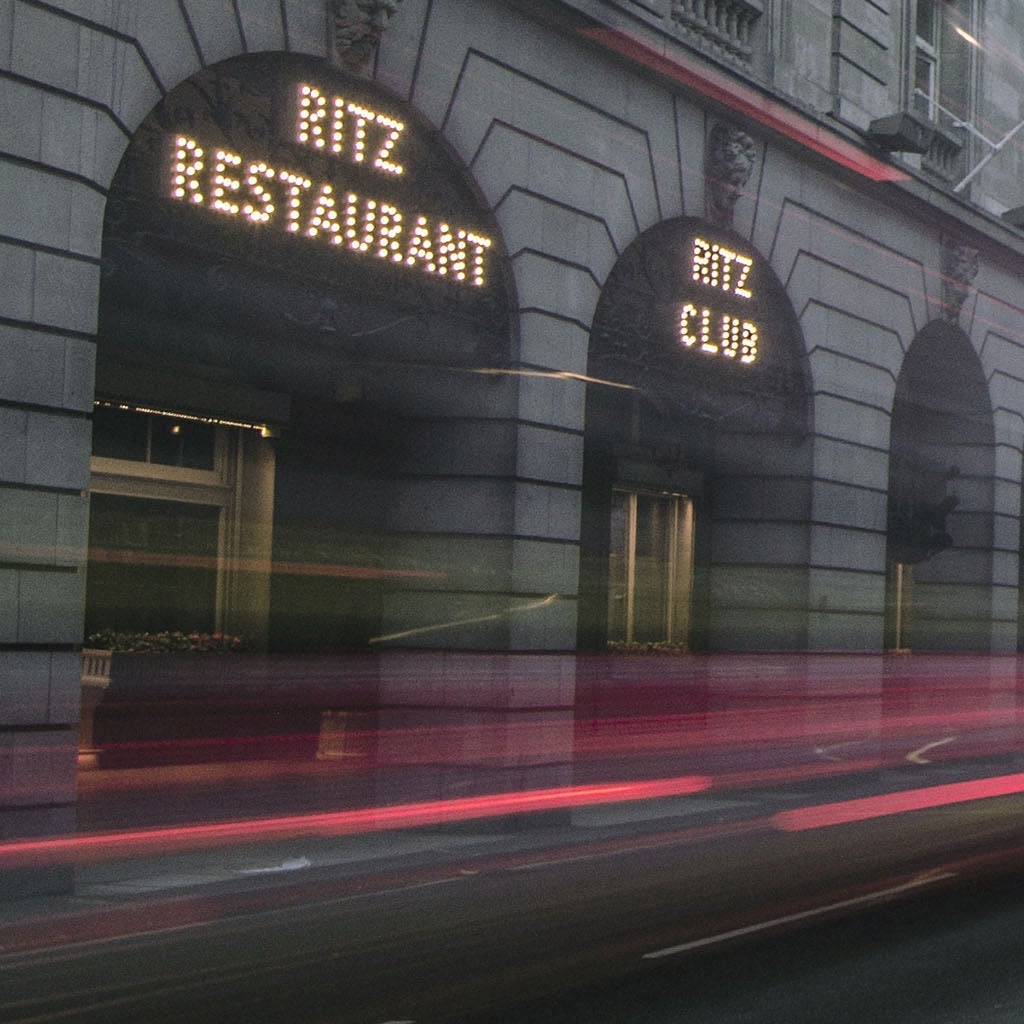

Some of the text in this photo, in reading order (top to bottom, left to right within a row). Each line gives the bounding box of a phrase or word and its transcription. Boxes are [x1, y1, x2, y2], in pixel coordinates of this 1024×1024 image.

[296, 84, 405, 175] RITZ
[172, 135, 492, 286] RESTAURANT
[692, 238, 752, 298] RITZ
[679, 303, 758, 363] CLUB
